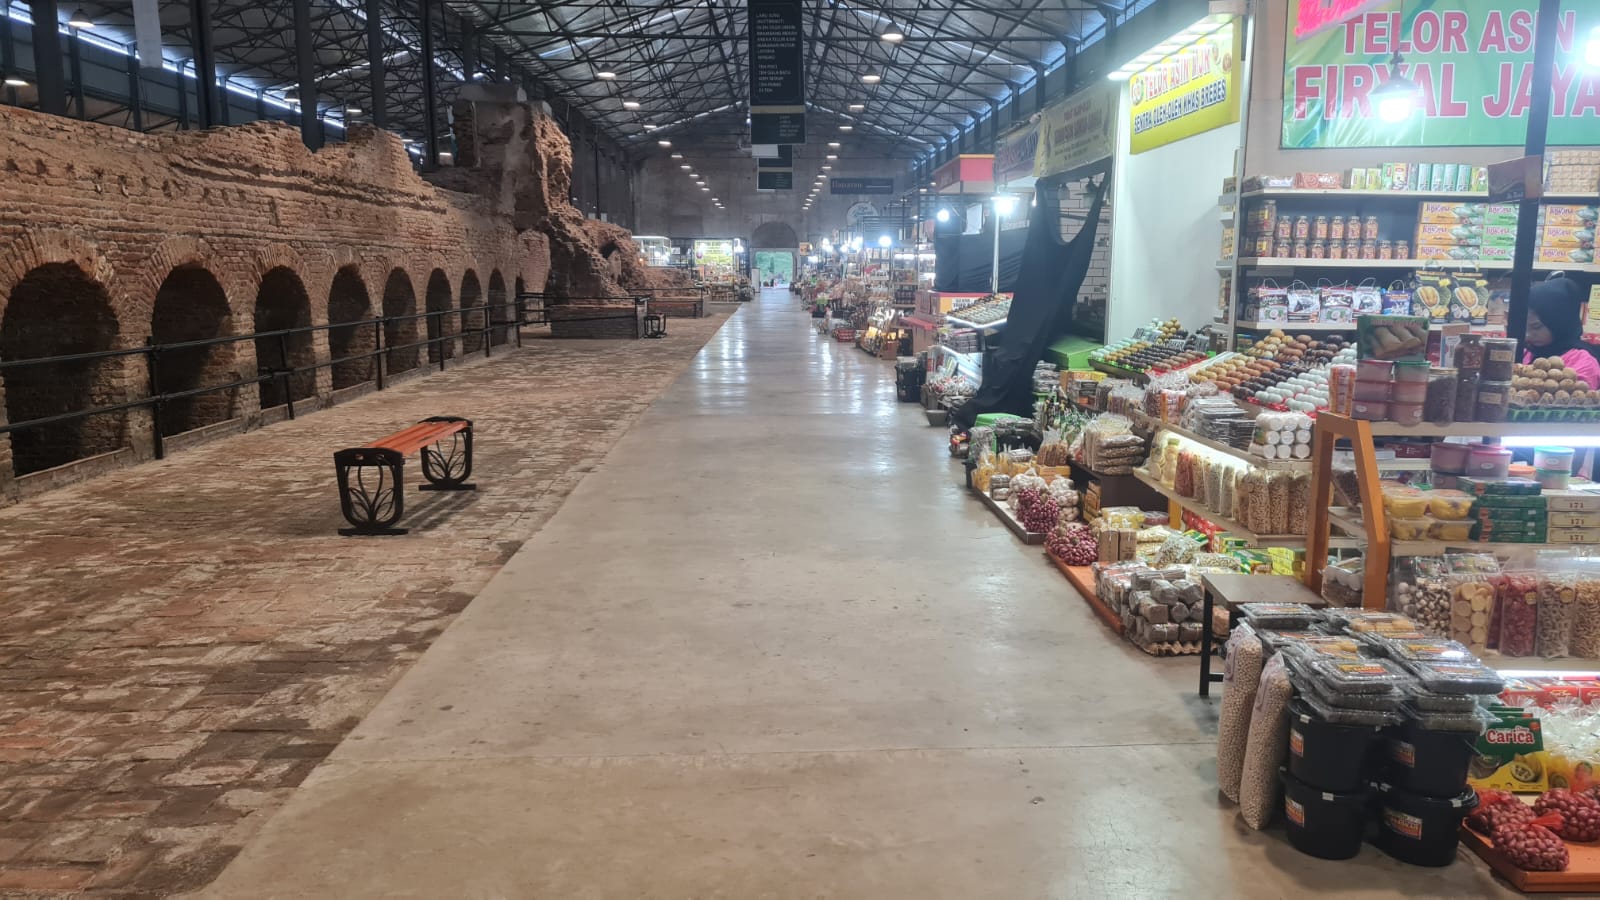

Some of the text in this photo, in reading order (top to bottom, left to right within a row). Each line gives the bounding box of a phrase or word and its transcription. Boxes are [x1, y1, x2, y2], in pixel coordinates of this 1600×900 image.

[1338, 11, 1468, 55] TELOR
[1477, 9, 1576, 53] ASN
[1144, 66, 1169, 102] TELOR
[1170, 58, 1190, 90] ASIN
[1135, 110, 1152, 133] SENTRA
[1153, 98, 1182, 127] OLEH-OLEH
[1183, 91, 1200, 116] KHAS
[1200, 79, 1226, 108] BREBES
[1486, 729, 1535, 744] Carica
